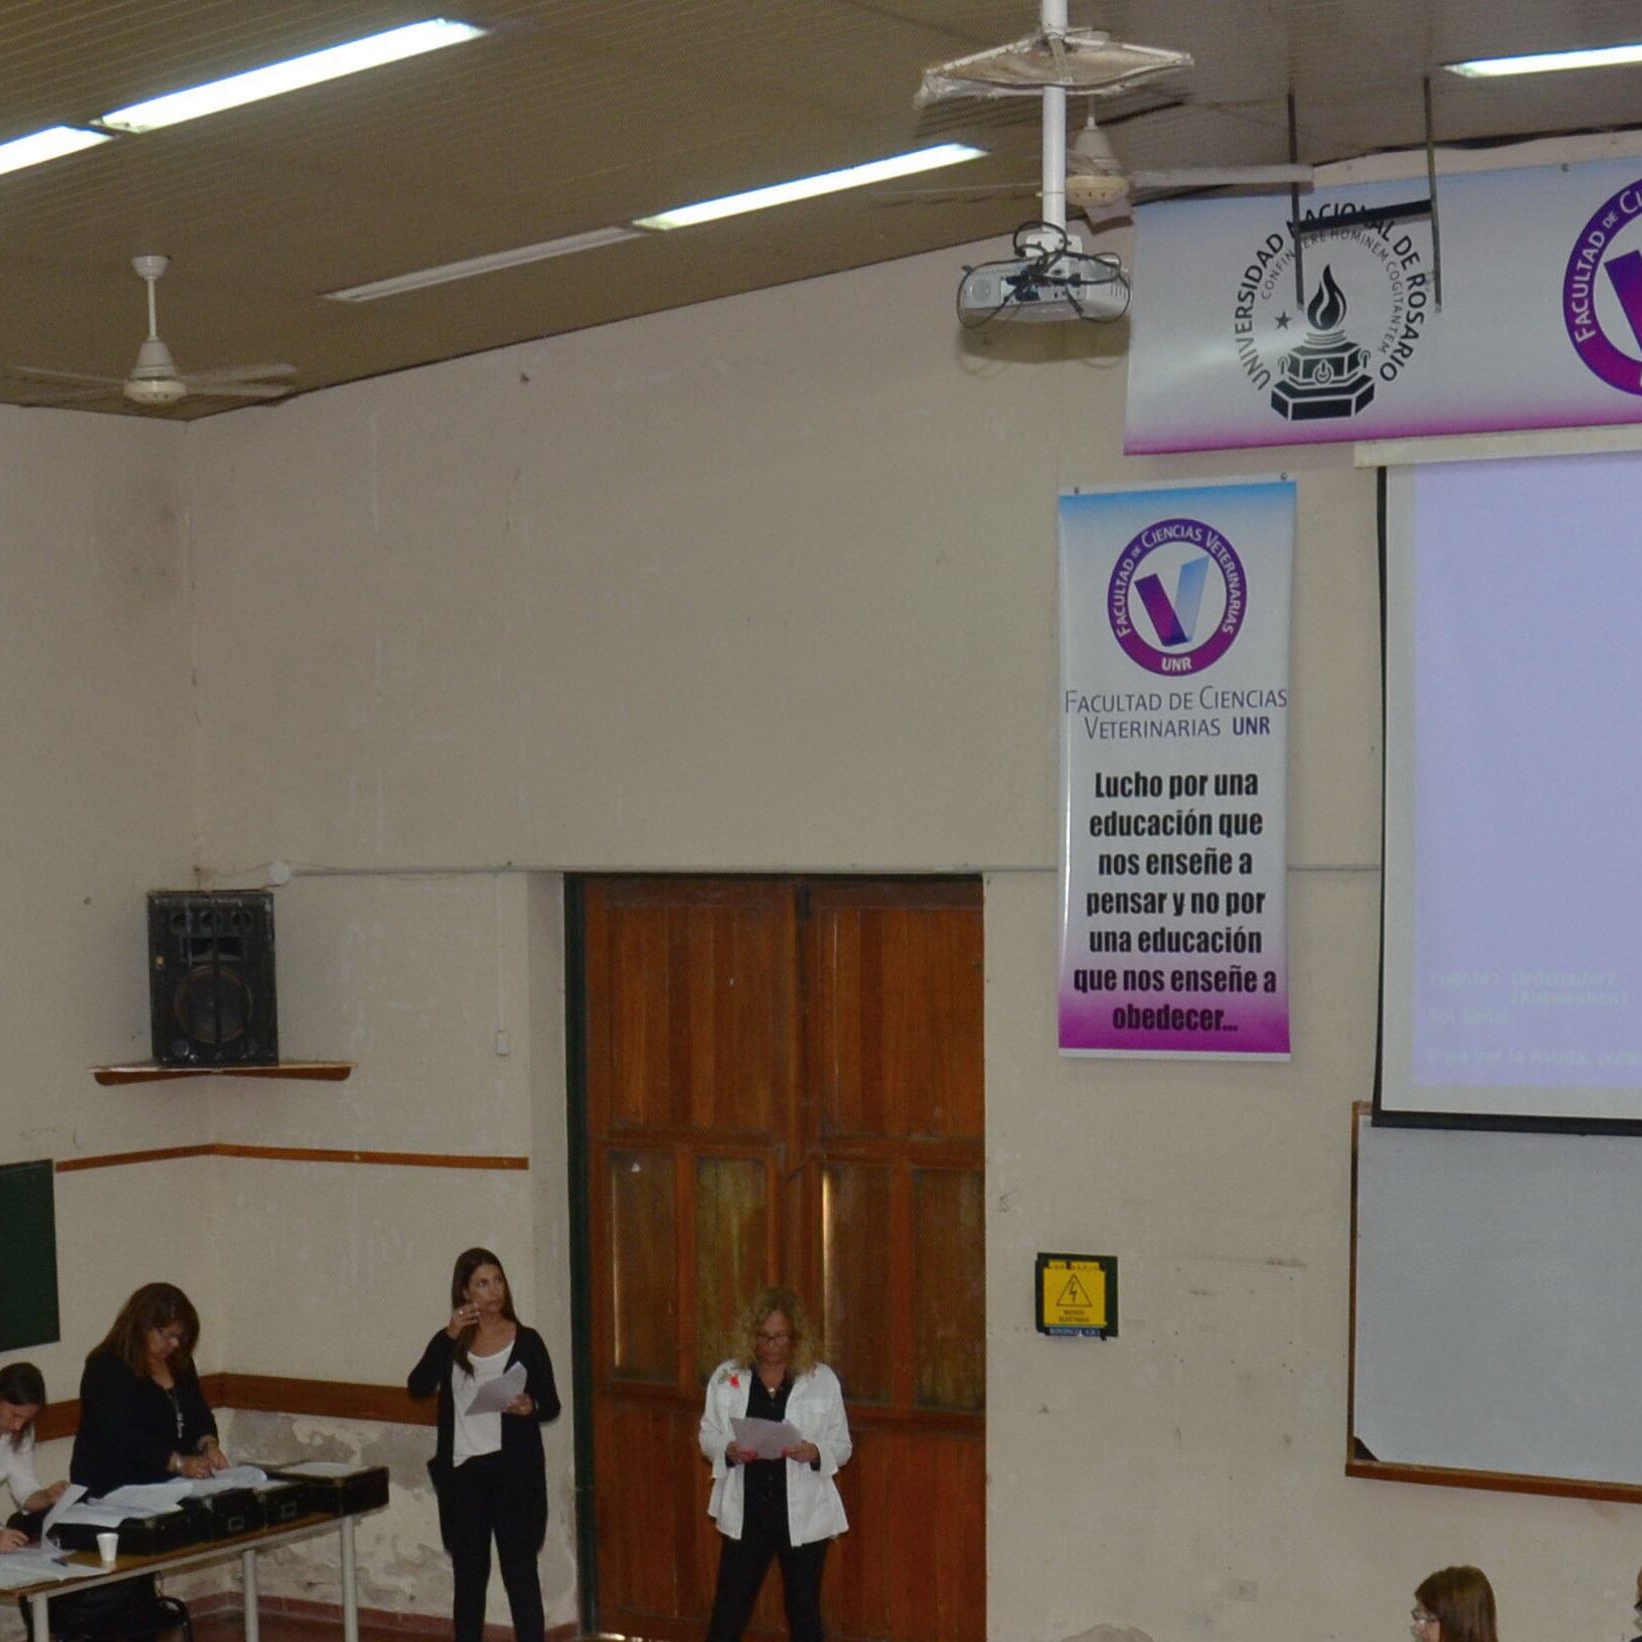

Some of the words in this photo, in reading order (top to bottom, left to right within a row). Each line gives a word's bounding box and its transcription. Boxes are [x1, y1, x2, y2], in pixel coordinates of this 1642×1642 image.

[1262, 230, 1326, 300] CONFINERE
[1393, 236, 1420, 270] DE
[1571, 231, 1606, 342] FACULTAD
[1235, 233, 1284, 390] UNIVERSIDAD
[1380, 273, 1427, 382] ROSARIO
[1112, 558, 1135, 638] FACULTAD
[1141, 524, 1203, 549] CIENCIAS
[1207, 531, 1242, 635] VETERINARIAS
[1161, 657, 1193, 672] UNR
[1065, 690, 1162, 714] FACULTAD
[1169, 692, 1193, 711] DE
[1199, 685, 1288, 709] CIENCIAS
[1084, 716, 1221, 740] VETERINARIAS
[1232, 716, 1270, 736] UNR
[1095, 771, 1162, 798] Lucho
[1169, 774, 1208, 800] por
[1214, 773, 1258, 796] una
[1089, 809, 1212, 837] educación
[1219, 812, 1263, 838] que
[1098, 853, 1140, 875] nos
[1146, 847, 1232, 875] enseñe
[1239, 852, 1252, 874] a
[1086, 892, 1167, 916] pensar
[1173, 892, 1185, 916] y
[1191, 892, 1219, 914] no
[1225, 892, 1266, 916] por
[1089, 930, 1131, 952] una
[1138, 927, 1262, 953] educación
[1074, 968, 1117, 993] que
[1123, 969, 1165, 991] nos
[1171, 965, 1257, 993] enseñe
[1263, 970, 1276, 993] a
[1112, 1004, 1238, 1032] obedecer...
